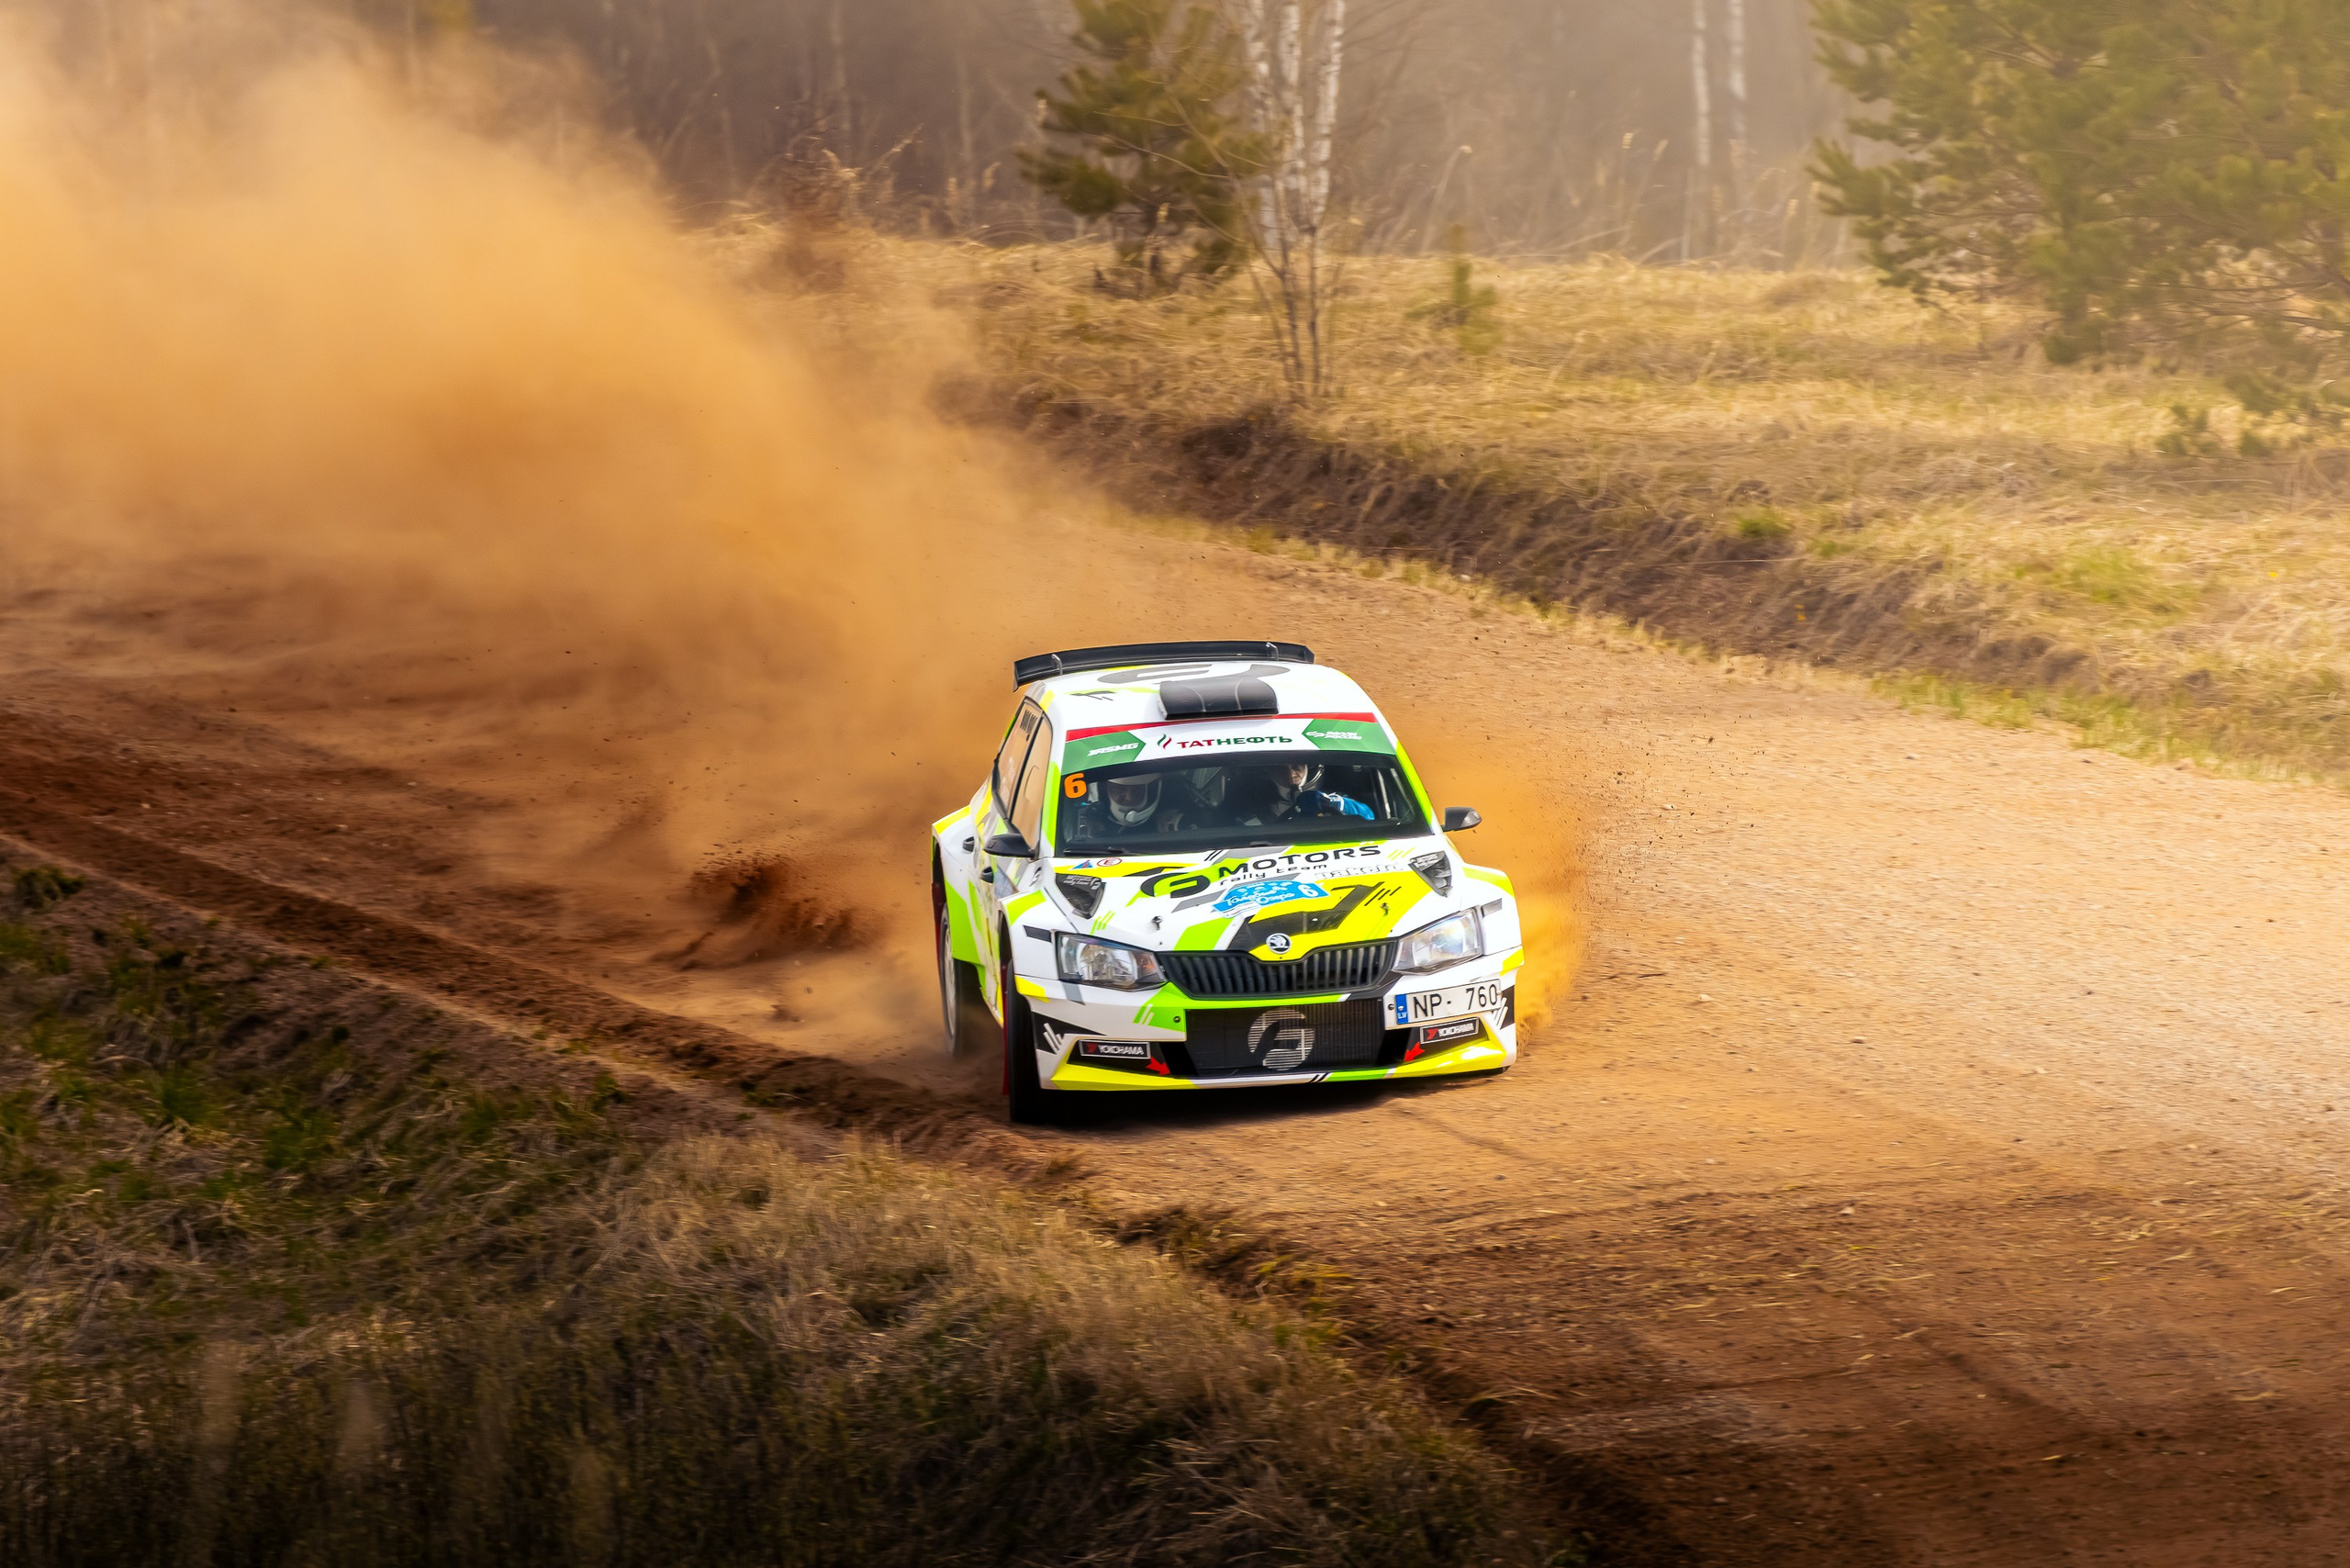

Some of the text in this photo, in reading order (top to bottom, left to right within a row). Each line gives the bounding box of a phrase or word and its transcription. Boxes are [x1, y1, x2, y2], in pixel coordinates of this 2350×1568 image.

[1176, 736, 1292, 749] ТАТНЕФТЬ
[1063, 772, 1088, 799] 6
[1218, 845, 1382, 879] MOTORS
[1219, 872, 1267, 886] rally
[1276, 864, 1328, 874] team
[1297, 884, 1319, 898] 6
[1465, 983, 1498, 1011] 760
